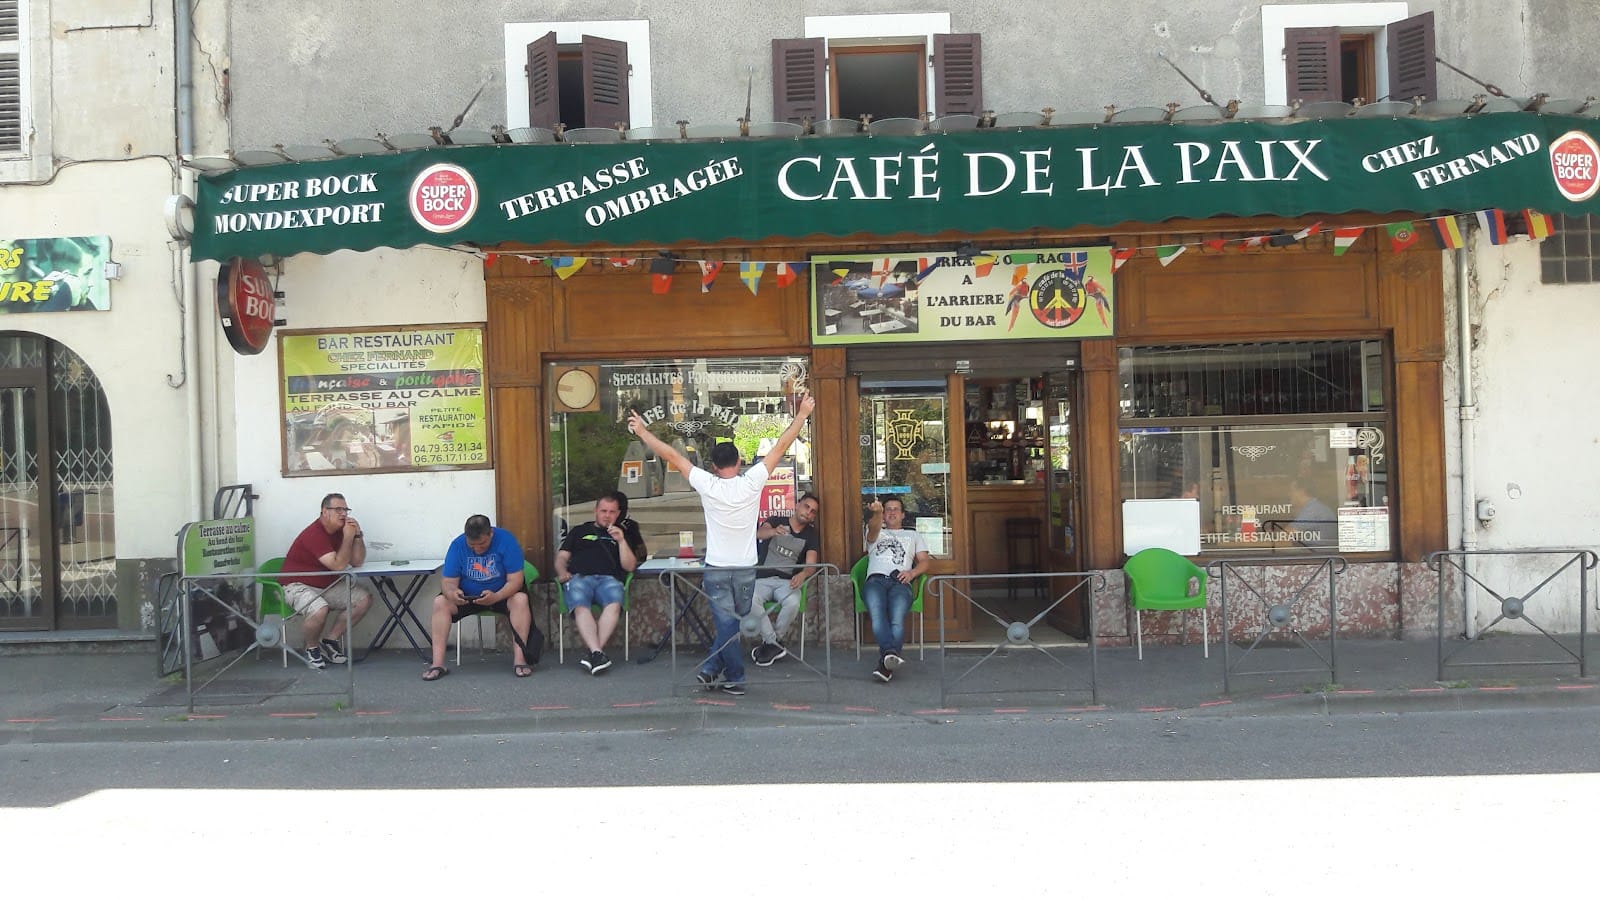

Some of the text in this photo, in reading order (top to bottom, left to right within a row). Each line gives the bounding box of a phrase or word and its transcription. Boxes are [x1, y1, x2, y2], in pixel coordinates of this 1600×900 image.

[1361, 135, 1440, 173] CHEZ
[1554, 153, 1593, 167] SUPER
[1412, 133, 1541, 190] FERNAND
[777, 139, 1329, 201] CAFÉ DE LA PAIX
[1558, 166, 1592, 180] BOCK
[220, 172, 378, 204] SUPER BOCK
[422, 185, 466, 199] SUPER
[500, 156, 649, 220] TERRASSE
[585, 156, 744, 227] OMBRAGÉE
[423, 198, 464, 212] BOCK
[214, 202, 385, 234] MONDEXPORT
[961, 274, 973, 285] A
[940, 315, 996, 327] DU BAR
[318, 332, 455, 350] BAR RESTAURANT
[328, 349, 434, 363] CHEZ FERNAND
[379, 378, 388, 386] &
[288, 387, 481, 403] TERRASSE AU CALME
[692, 400, 704, 414] la
[419, 413, 476, 423] RESTAURATION
[413, 442, 482, 453] 04.79.33.21.34
[414, 453, 484, 464] 06.76.17.11.02
[768, 494, 785, 510] ICI
[759, 510, 768, 519] LE
[1222, 504, 1292, 515] RESTAURANT
[1253, 518, 1261, 528] &
[1199, 531, 1321, 544] ETITE RESTAURATION
